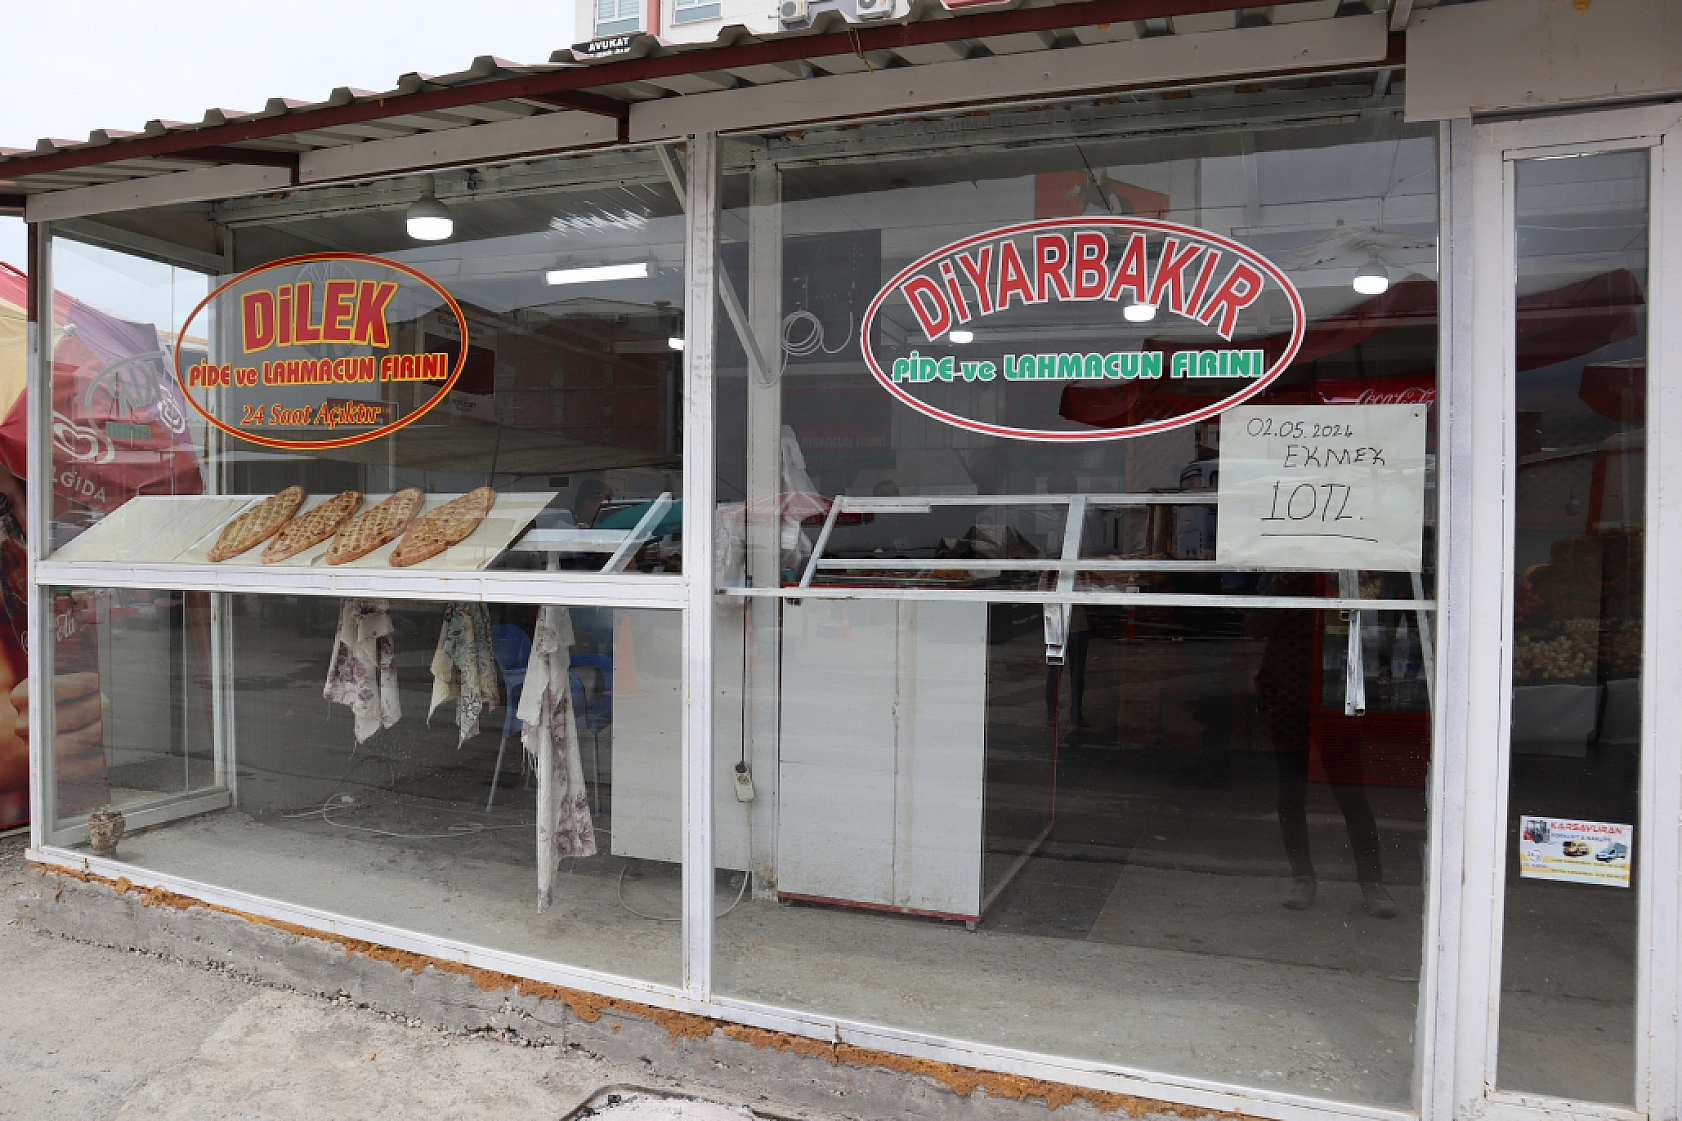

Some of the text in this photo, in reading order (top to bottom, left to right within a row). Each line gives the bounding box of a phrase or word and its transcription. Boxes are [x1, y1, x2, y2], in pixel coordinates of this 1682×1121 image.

[588, 37, 630, 52] AVUKAT
[188, 352, 449, 389] PİDE ve LAHMACUN FIRINI
[890, 349, 1265, 383] PİDE ve LAHMACUN FIRINI
[240, 403, 265, 425] 24
[268, 402, 310, 425] Saat
[313, 400, 382, 429] Açıktır
[1283, 444, 1385, 468] EKMEK
[1550, 821, 1622, 836] KARSAVURAN
